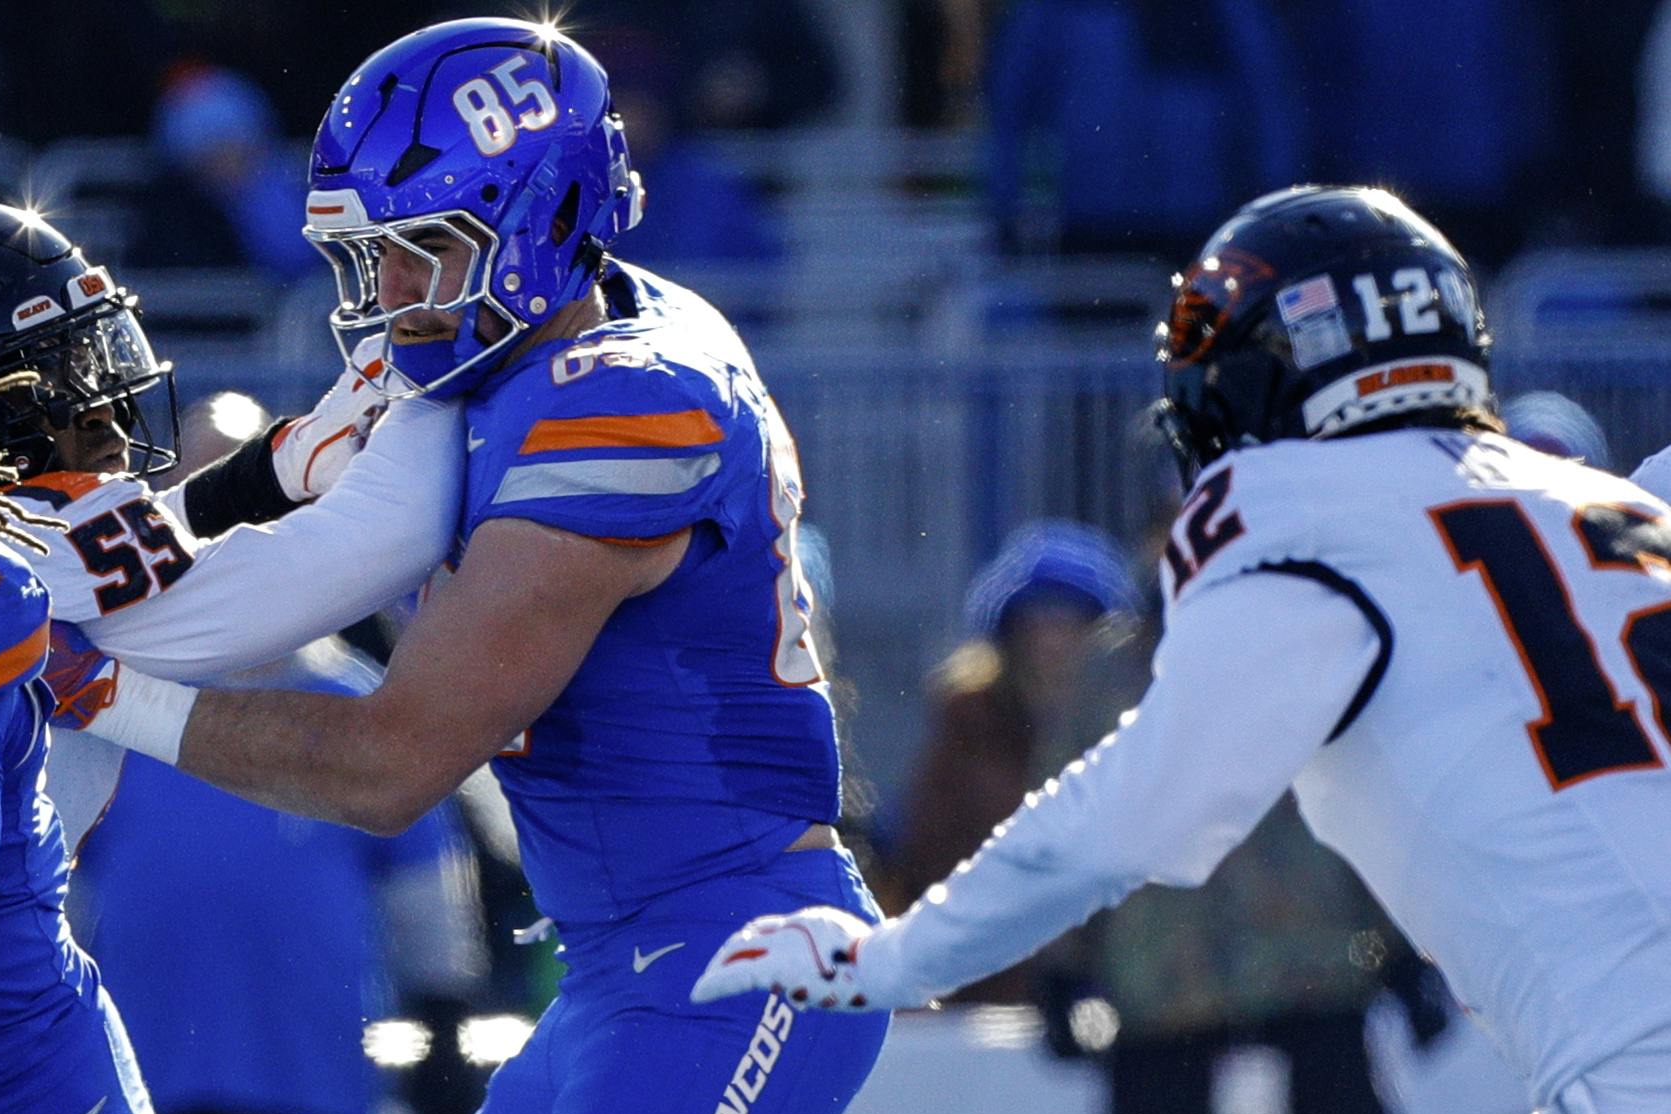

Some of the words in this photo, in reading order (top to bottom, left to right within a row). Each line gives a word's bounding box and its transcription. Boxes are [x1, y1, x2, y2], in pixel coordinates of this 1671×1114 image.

[452, 54, 559, 158] 85
[1352, 268, 1441, 342] 12
[65, 497, 196, 617] 55
